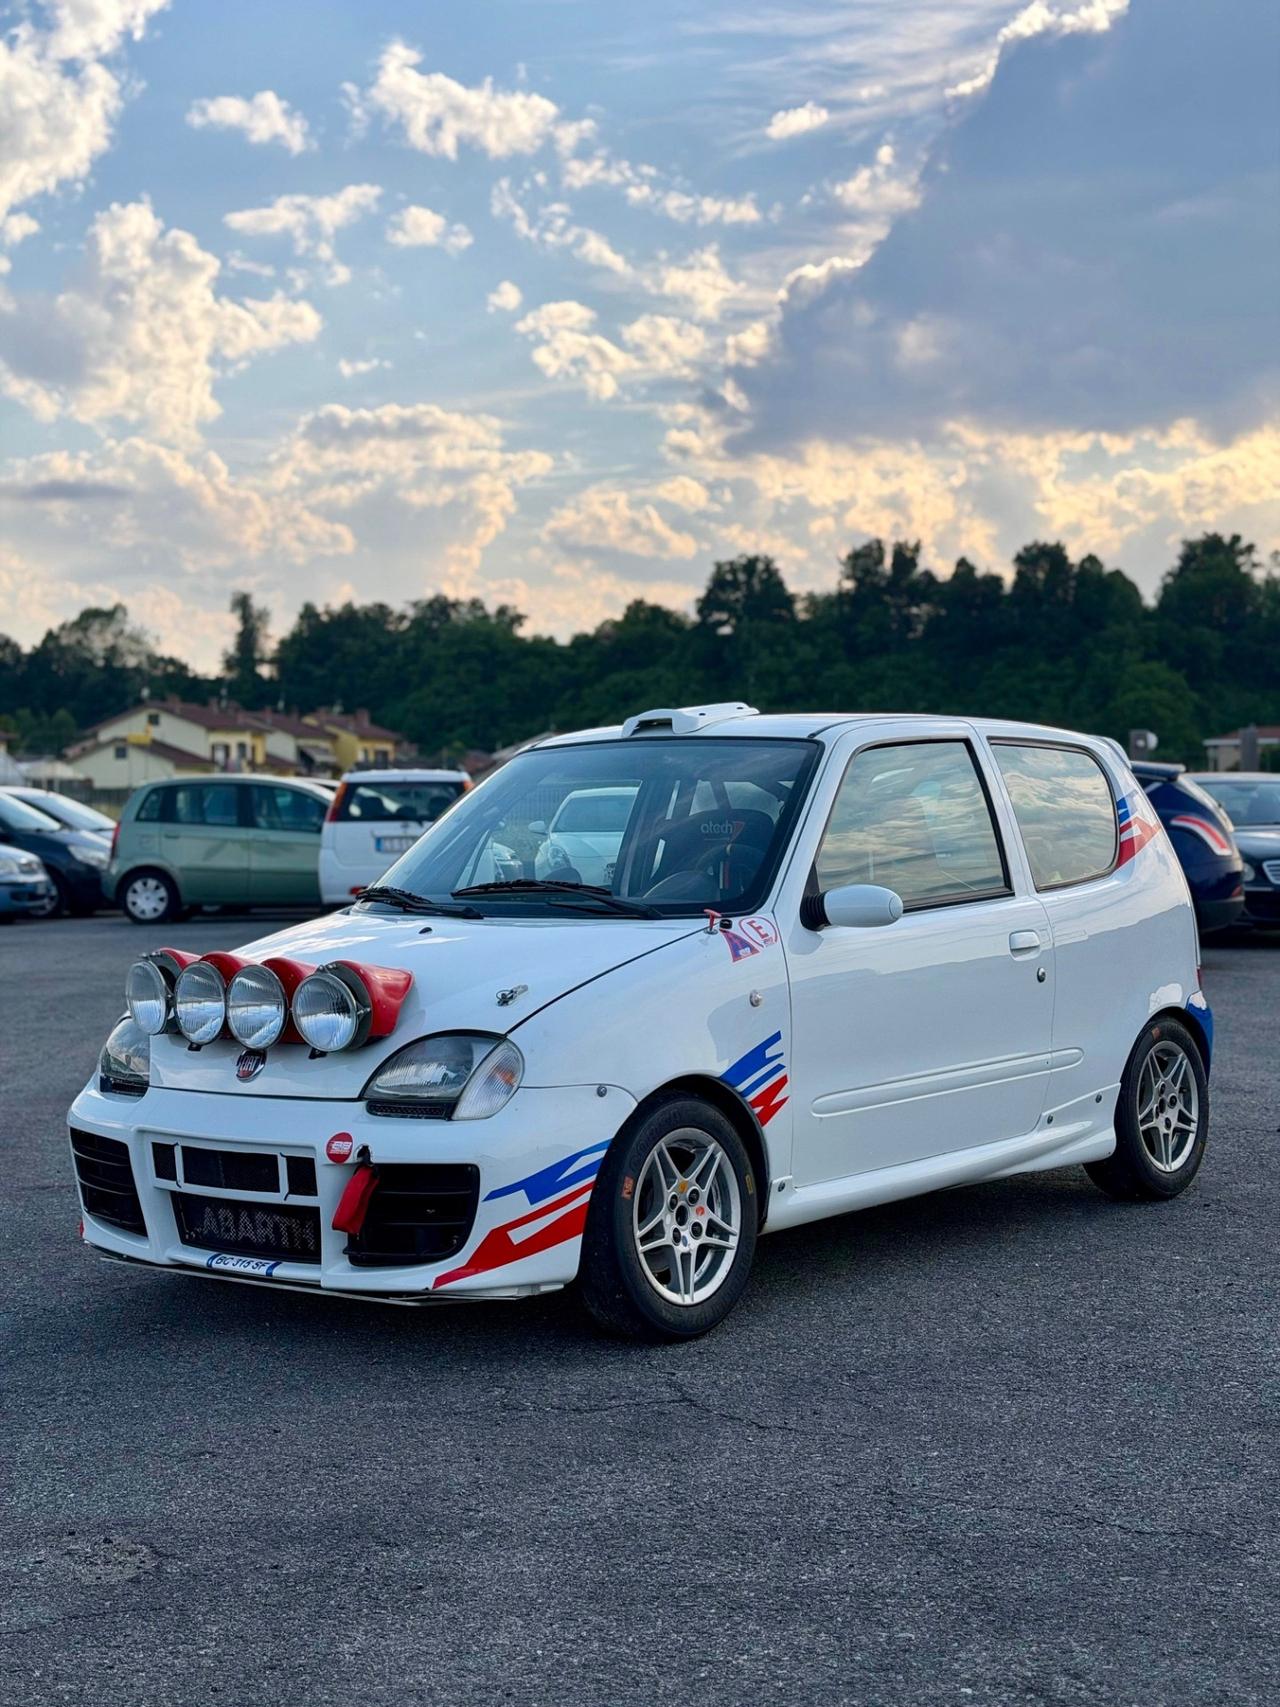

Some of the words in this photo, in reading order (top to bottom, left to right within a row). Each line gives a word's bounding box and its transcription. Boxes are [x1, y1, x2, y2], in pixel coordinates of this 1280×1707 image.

[202, 1206, 315, 1251] ABARTH
[215, 1255, 233, 1266] BC
[251, 1261, 270, 1271] SF
